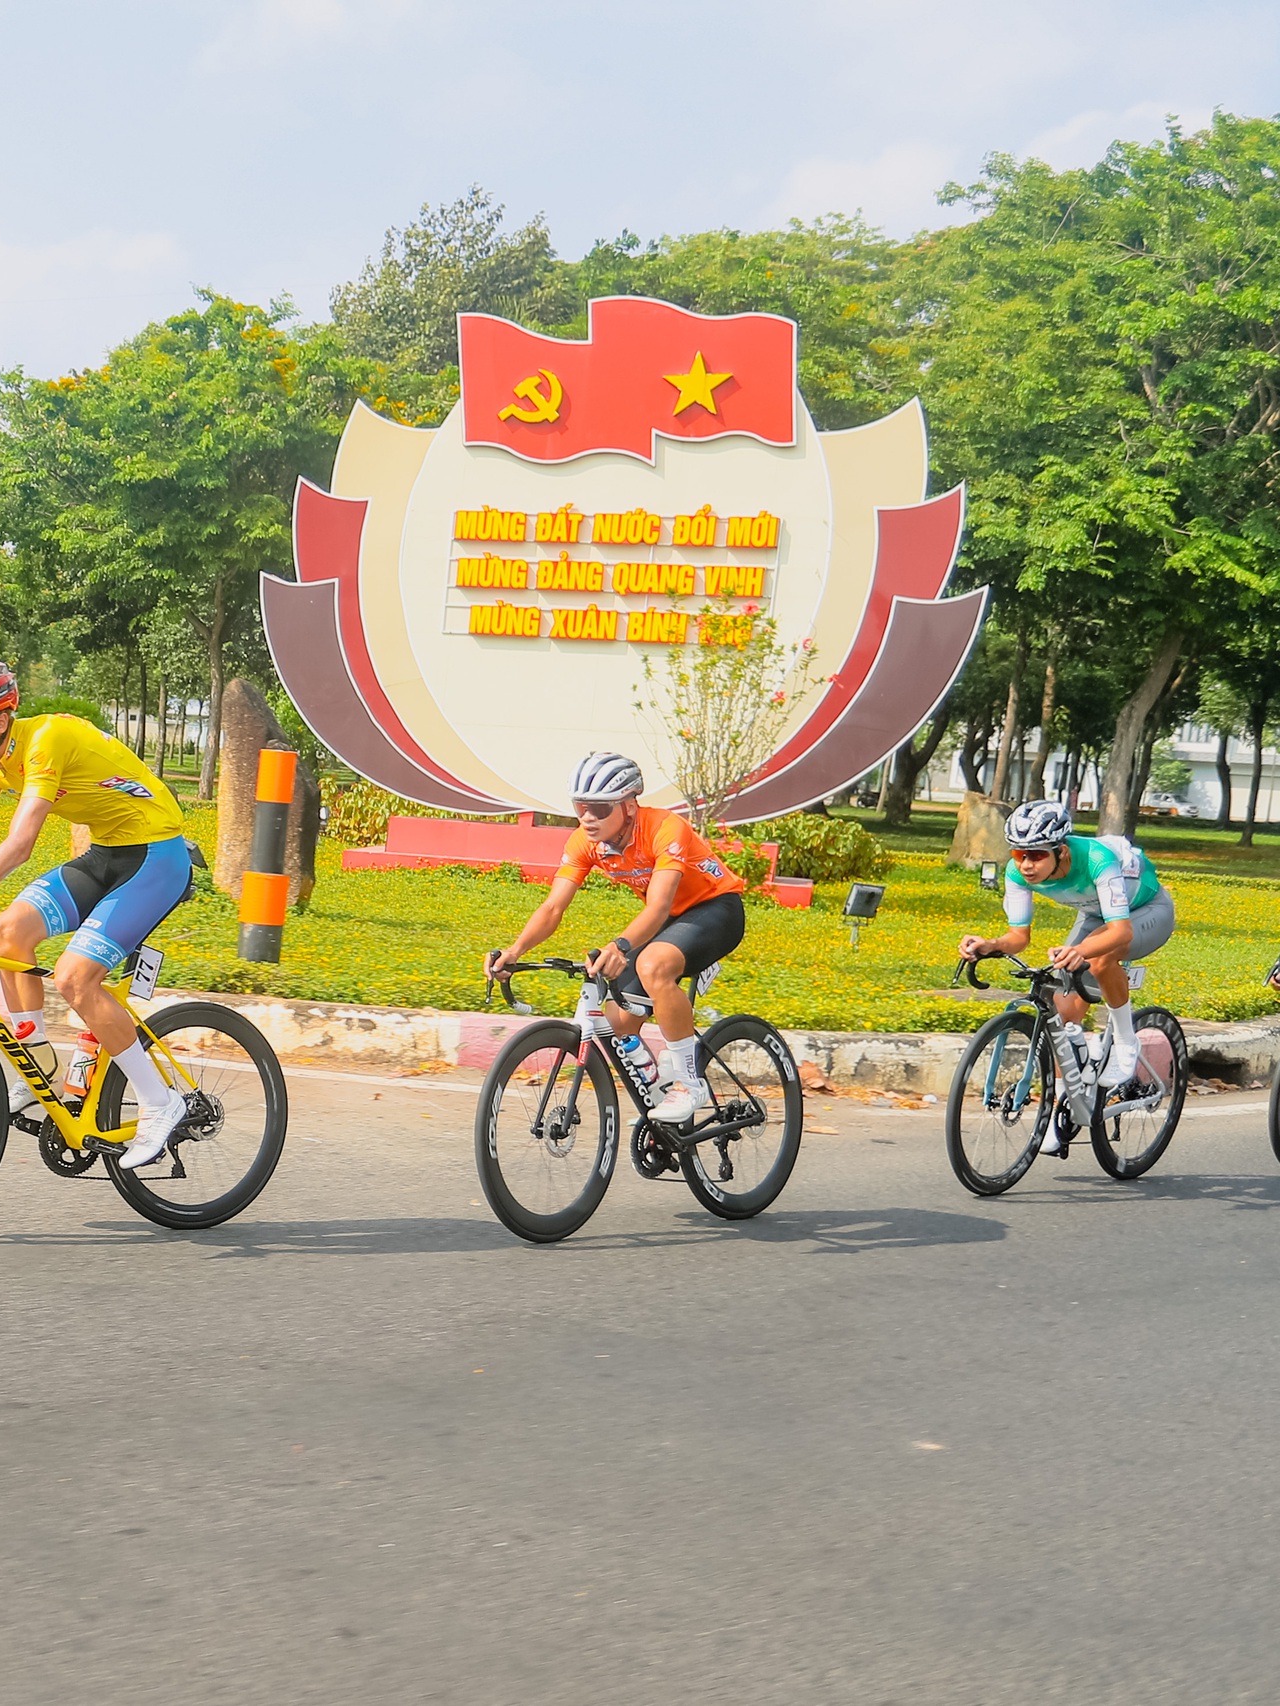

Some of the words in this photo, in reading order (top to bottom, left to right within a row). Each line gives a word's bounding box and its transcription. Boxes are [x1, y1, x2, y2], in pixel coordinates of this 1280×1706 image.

[454, 505, 526, 541] MỪNG
[535, 503, 584, 543] ĐẤT
[592, 507, 661, 545] NƯỚC
[672, 504, 717, 547] ĐỔI
[726, 511, 779, 548] MỚI
[456, 552, 529, 589] MỪNG
[536, 551, 604, 592] ĐẢNG
[611, 562, 696, 597] QUANG
[704, 565, 766, 598] VINH
[469, 600, 542, 637] MỪNG
[549, 604, 619, 640] XUÂN
[626, 607, 690, 645] BÍNH
[135, 959, 154, 984] 77
[610, 1036, 654, 1108] COLNAGO
[1047, 1013, 1086, 1099] FACTOR
